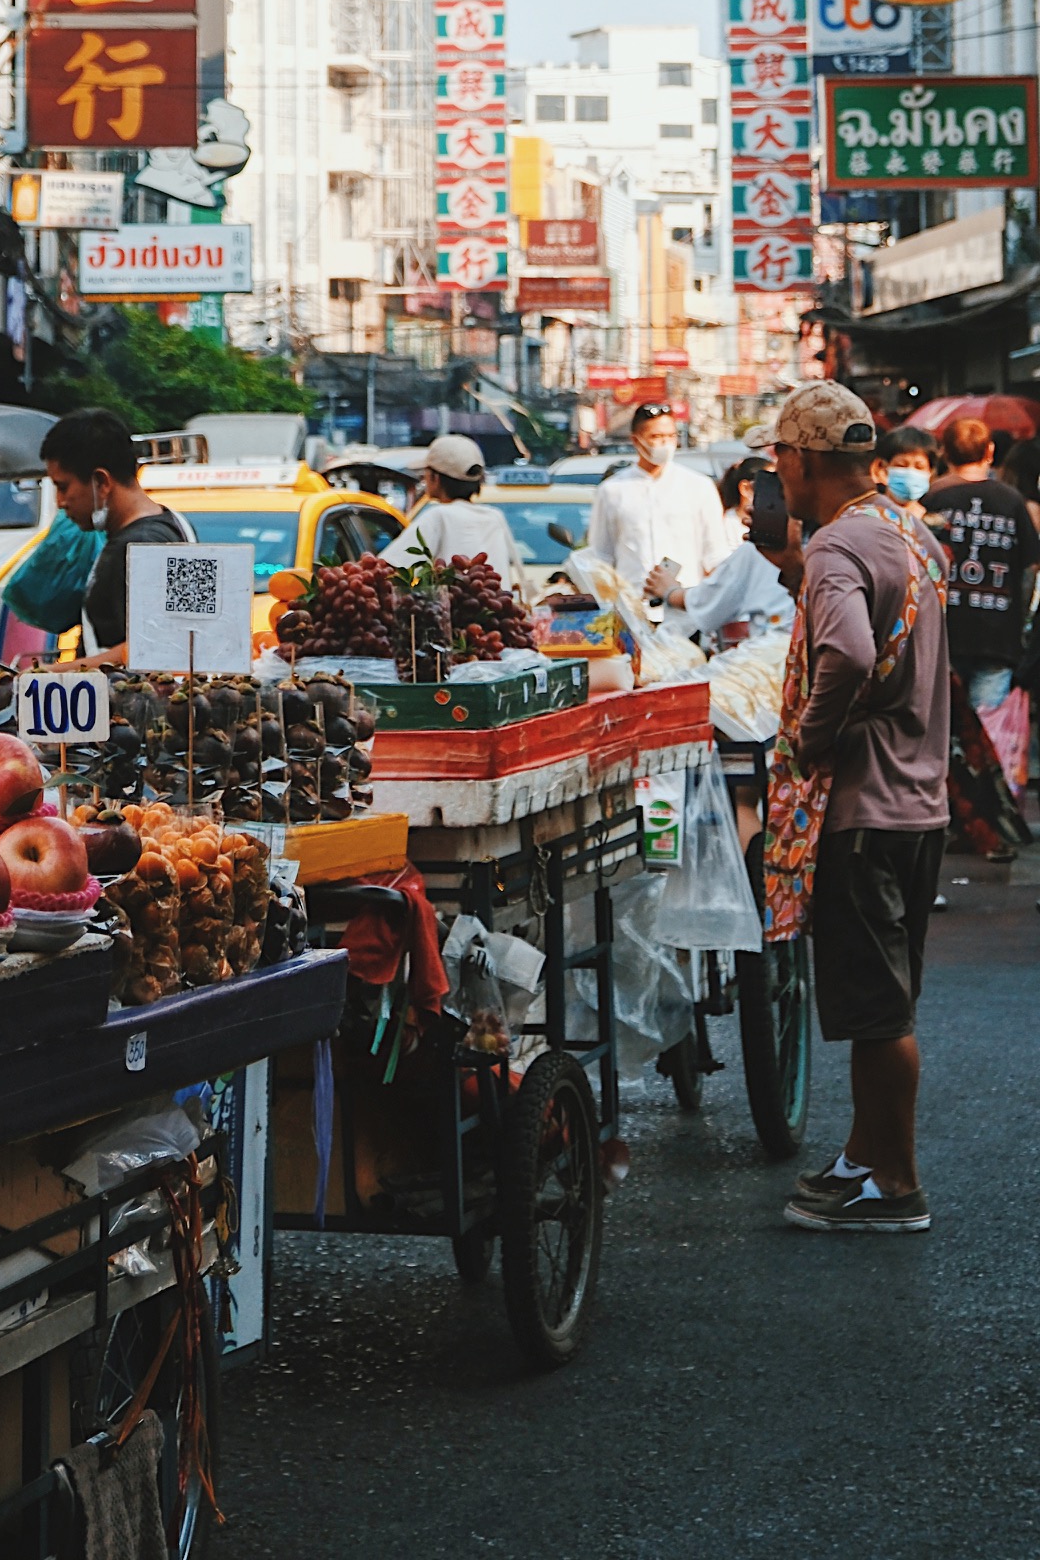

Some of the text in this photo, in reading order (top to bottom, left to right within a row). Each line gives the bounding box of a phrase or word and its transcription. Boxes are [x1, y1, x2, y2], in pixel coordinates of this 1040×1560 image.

[837, 83, 1026, 148] ฉ.มั่นคง
[949, 558, 1010, 589] OT
[25, 679, 97, 736] 100
